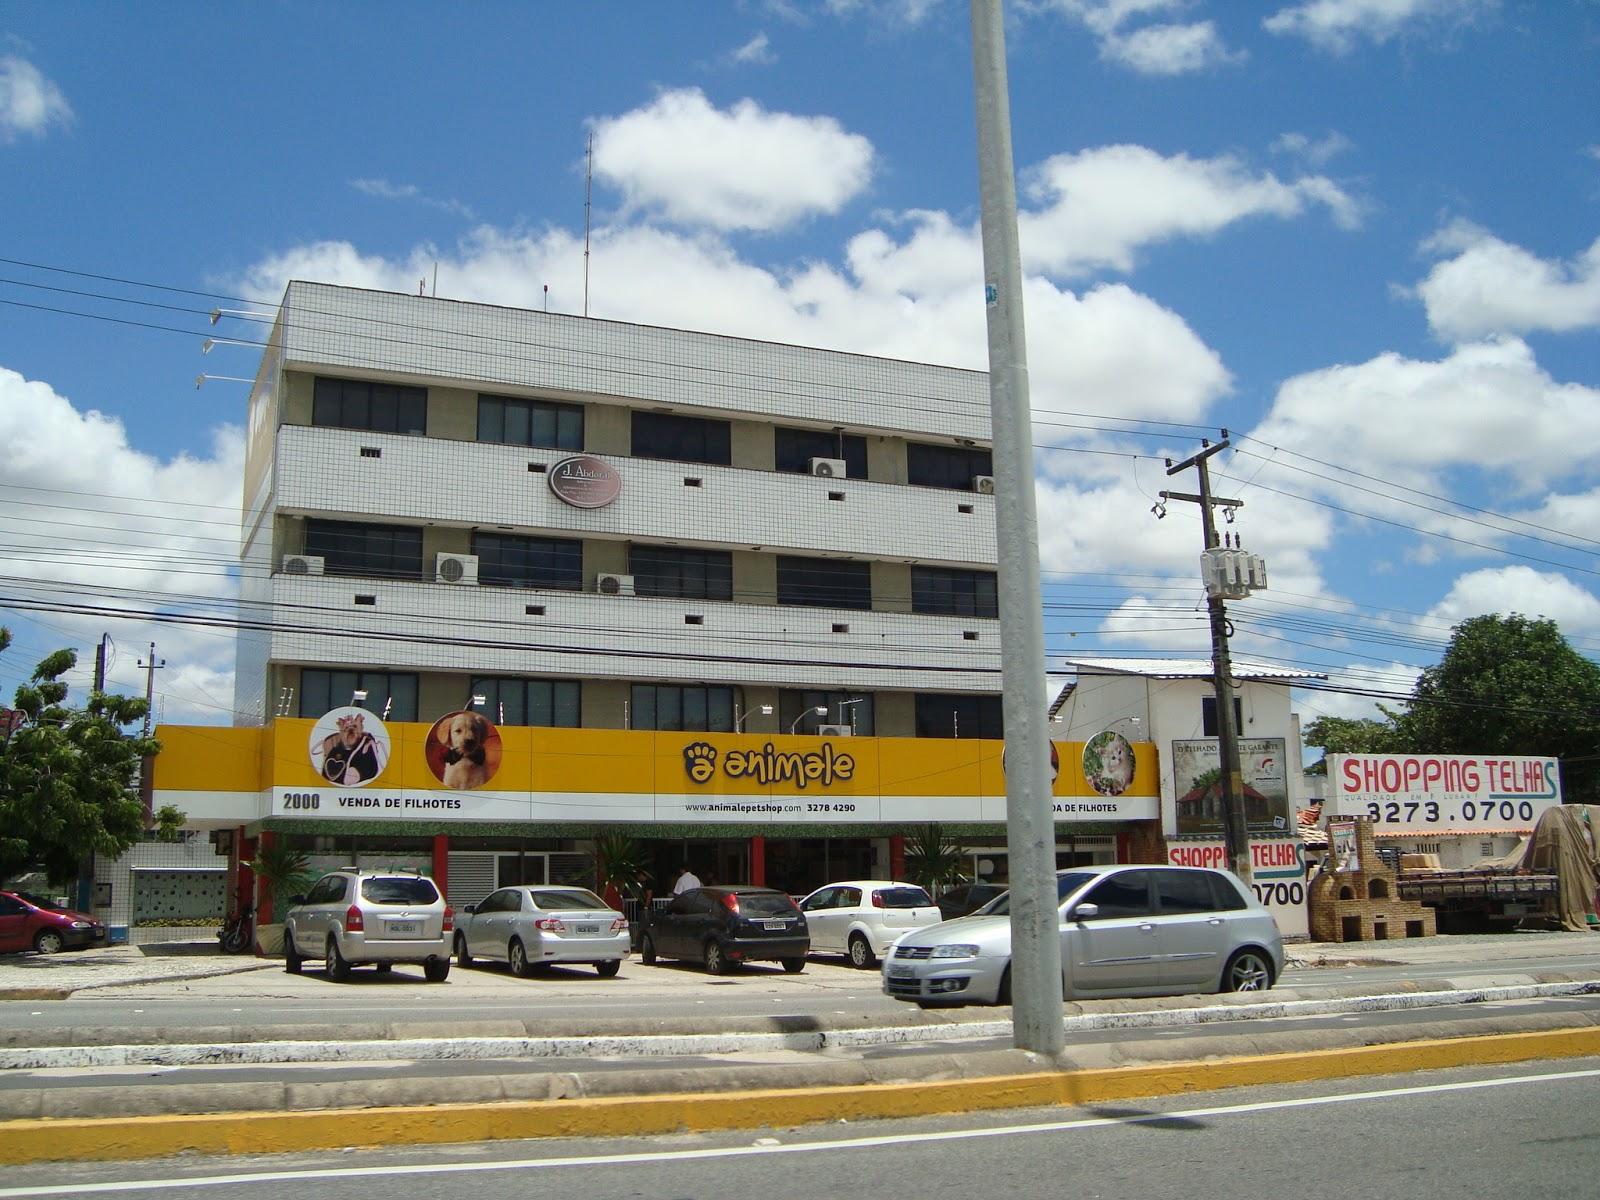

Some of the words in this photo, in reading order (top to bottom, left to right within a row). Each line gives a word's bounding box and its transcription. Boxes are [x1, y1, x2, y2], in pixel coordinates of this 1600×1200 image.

[562, 464, 573, 476] J.
[724, 743, 855, 788] animale
[1343, 758, 1480, 793] SHOPPING
[1484, 760, 1557, 799] TELHAS
[283, 793, 320, 810] 2000
[338, 797, 380, 808] VENDA
[385, 798, 400, 808] DE
[404, 799, 461, 809] FILHOTES
[685, 803, 802, 813] www.animalepetshop.com
[807, 803, 830, 812] 3278
[833, 803, 856, 812] 4290
[1065, 804, 1076, 812] DE
[1079, 804, 1117, 812] FILHOTES
[1367, 801, 1533, 823] 3273.0700
[1251, 843, 1305, 879] TELHAS
